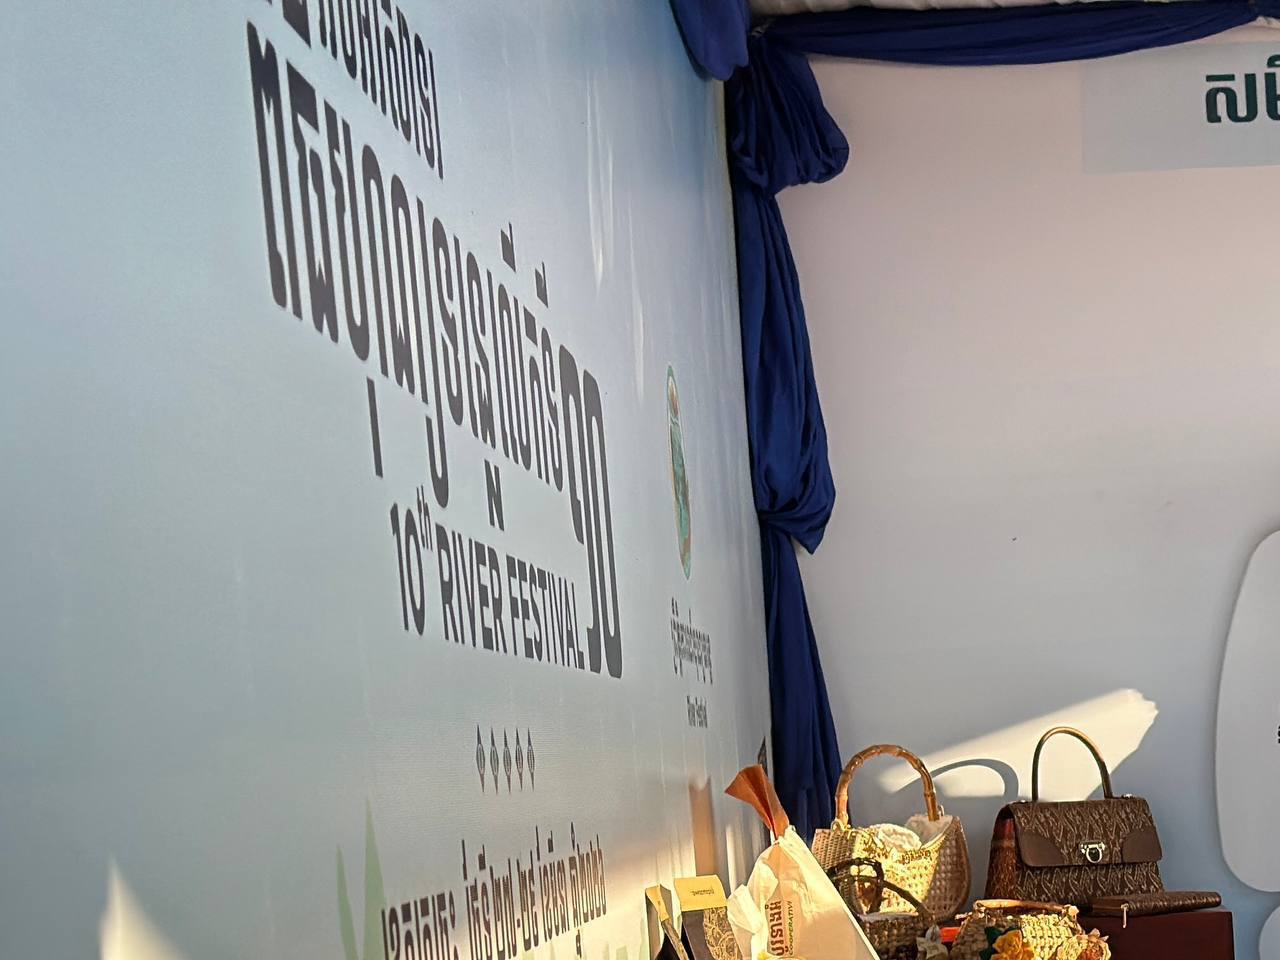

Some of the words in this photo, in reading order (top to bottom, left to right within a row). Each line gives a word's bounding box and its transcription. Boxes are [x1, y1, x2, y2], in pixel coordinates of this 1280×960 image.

[247, 0, 624, 680] ពធីបុណ្យទន្លេលើកទី១០
[390, 485, 434, 637] 10th
[435, 522, 508, 655] RIVER
[505, 554, 586, 671] FESTIVAL
